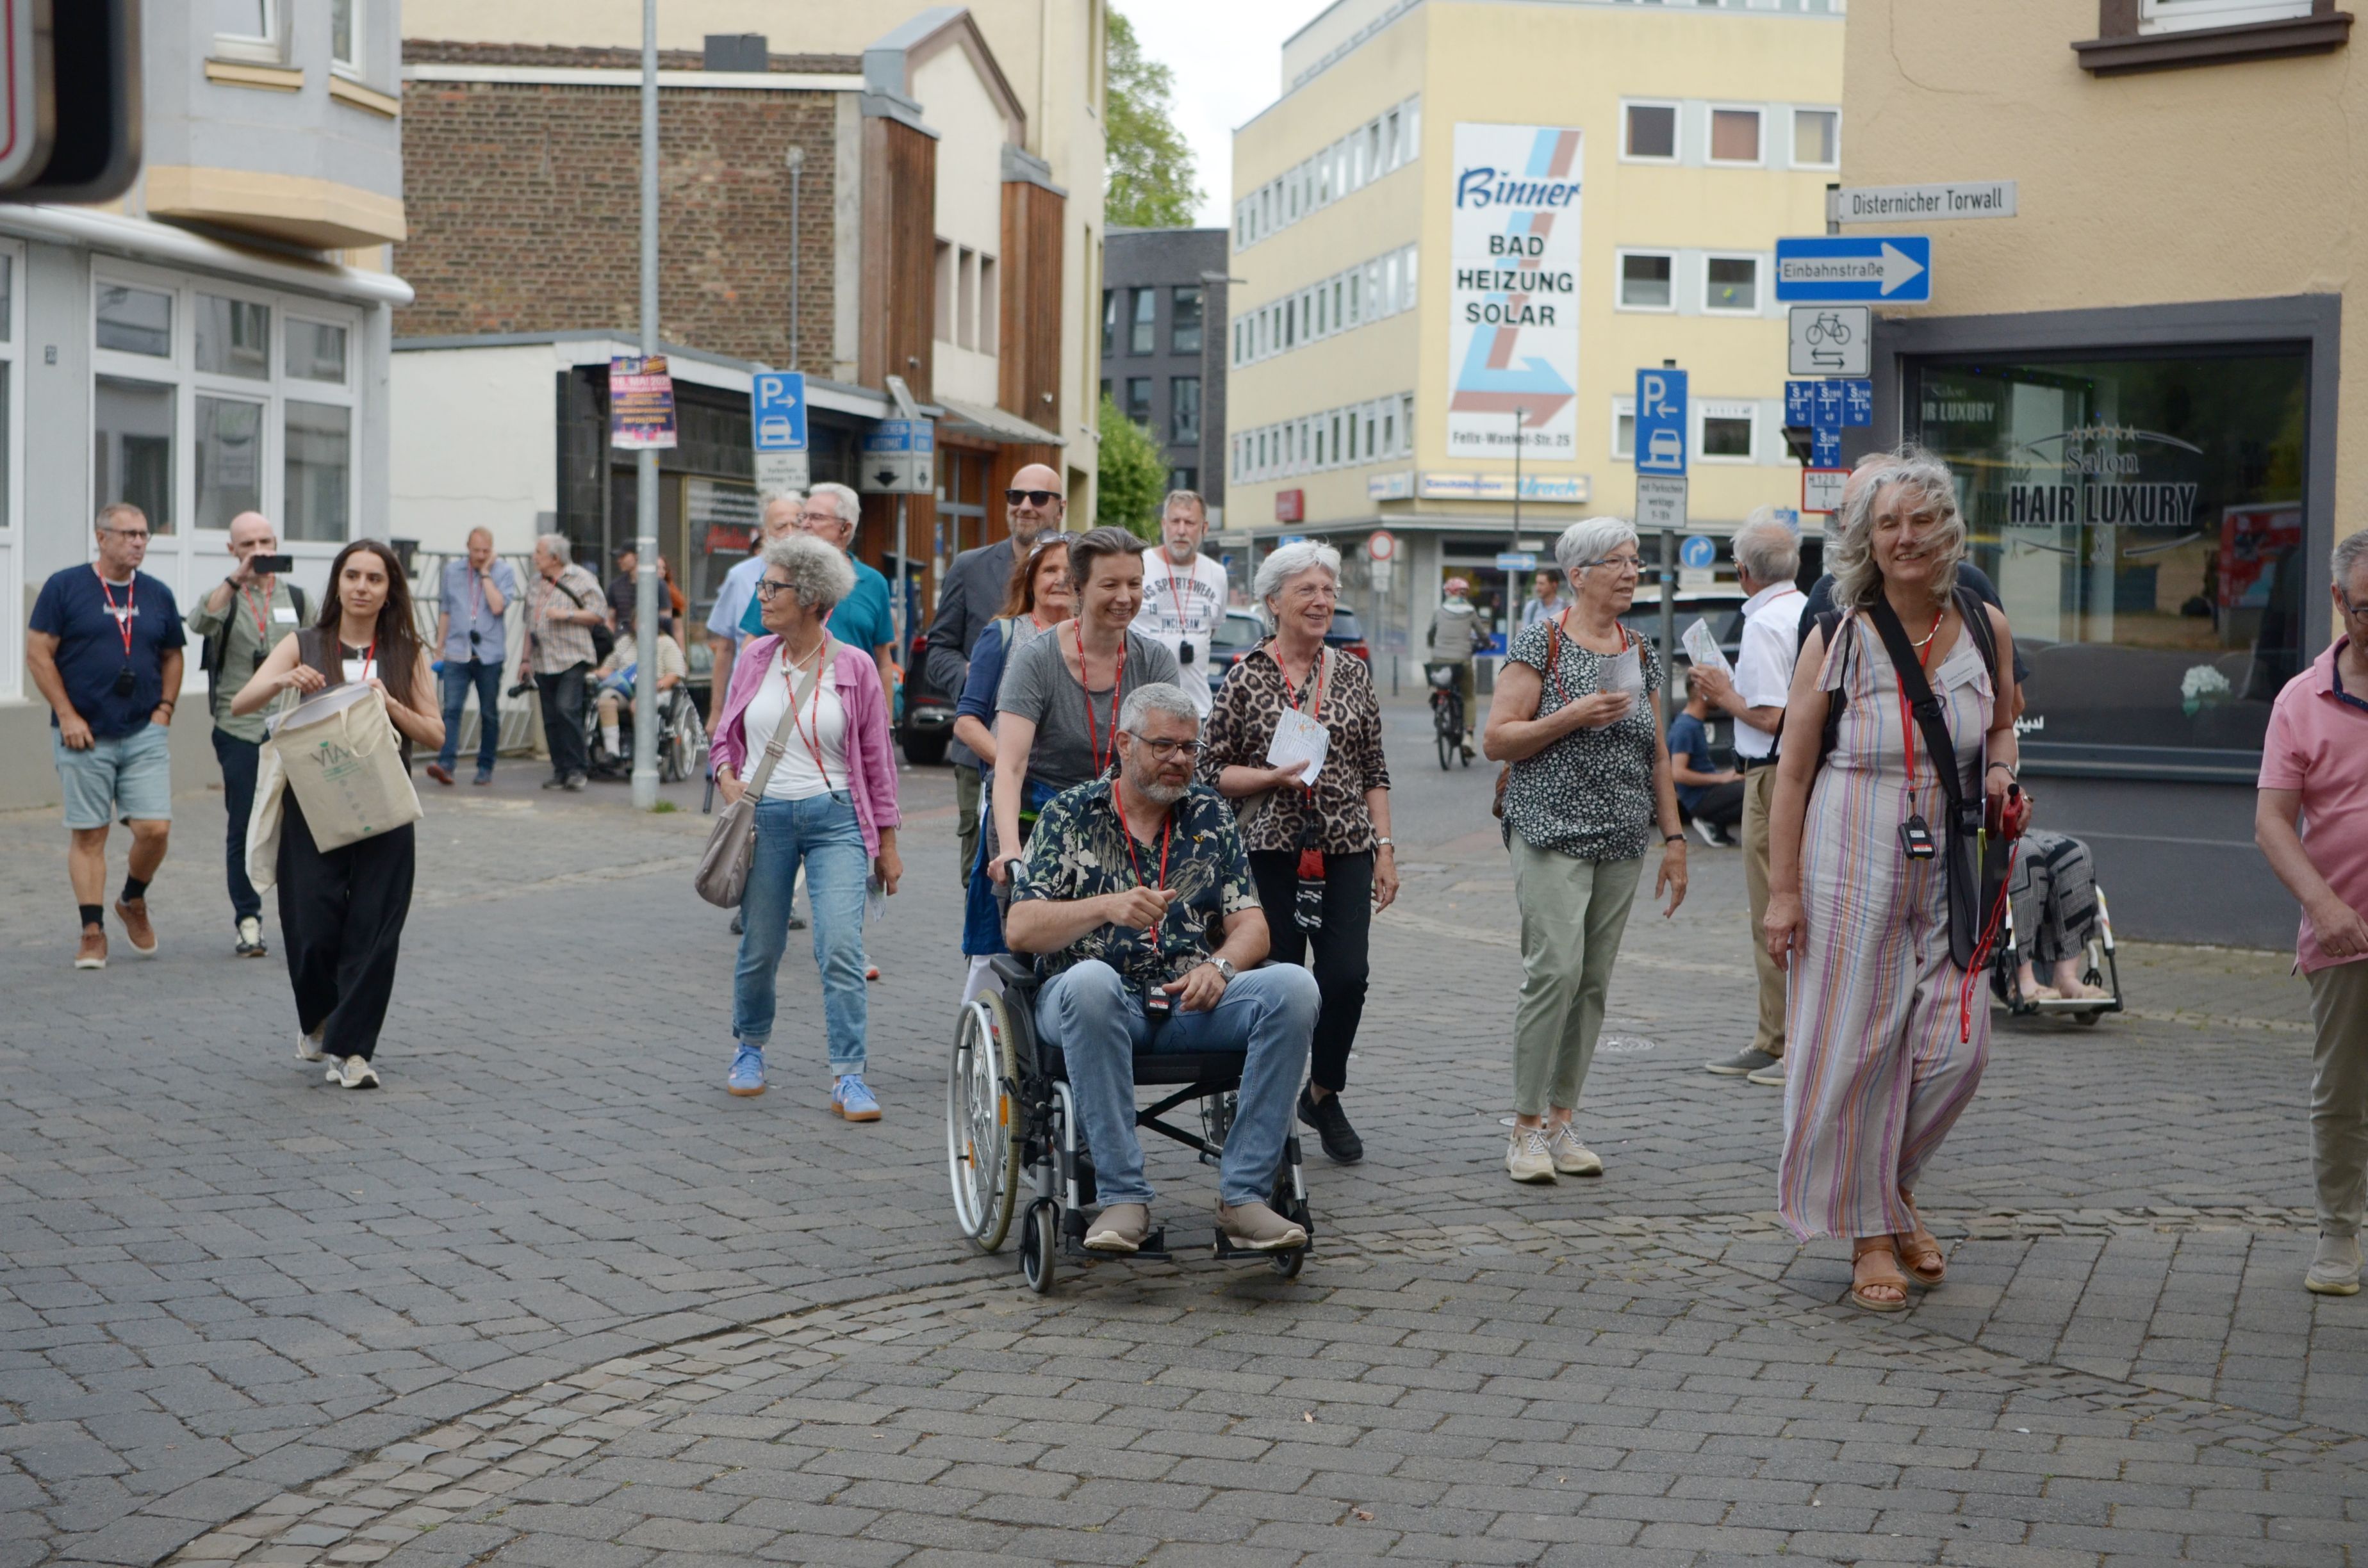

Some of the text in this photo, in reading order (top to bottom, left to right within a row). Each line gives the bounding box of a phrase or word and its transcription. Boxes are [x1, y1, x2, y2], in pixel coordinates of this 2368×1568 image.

[1456, 167, 1581, 210] Binner
[1853, 188, 2003, 215] Disternicher Torwall
[1490, 235, 1544, 256] BAD
[1457, 269, 1574, 293] HEIZUNG
[1784, 262, 1885, 278] Einbahnstraße
[1465, 302, 1556, 326] SOLAR
[761, 377, 784, 409] P
[1643, 375, 1666, 417] P
[1939, 402, 1995, 422] LUXURY
[1556, 434, 1570, 447] 25
[2065, 447, 2139, 474] Salon
[2009, 483, 2077, 525] HAIR
[2084, 483, 2198, 527] LUXURY
[1155, 577, 1216, 603] SPORTSWEAR
[1185, 618, 1200, 630] SAM
